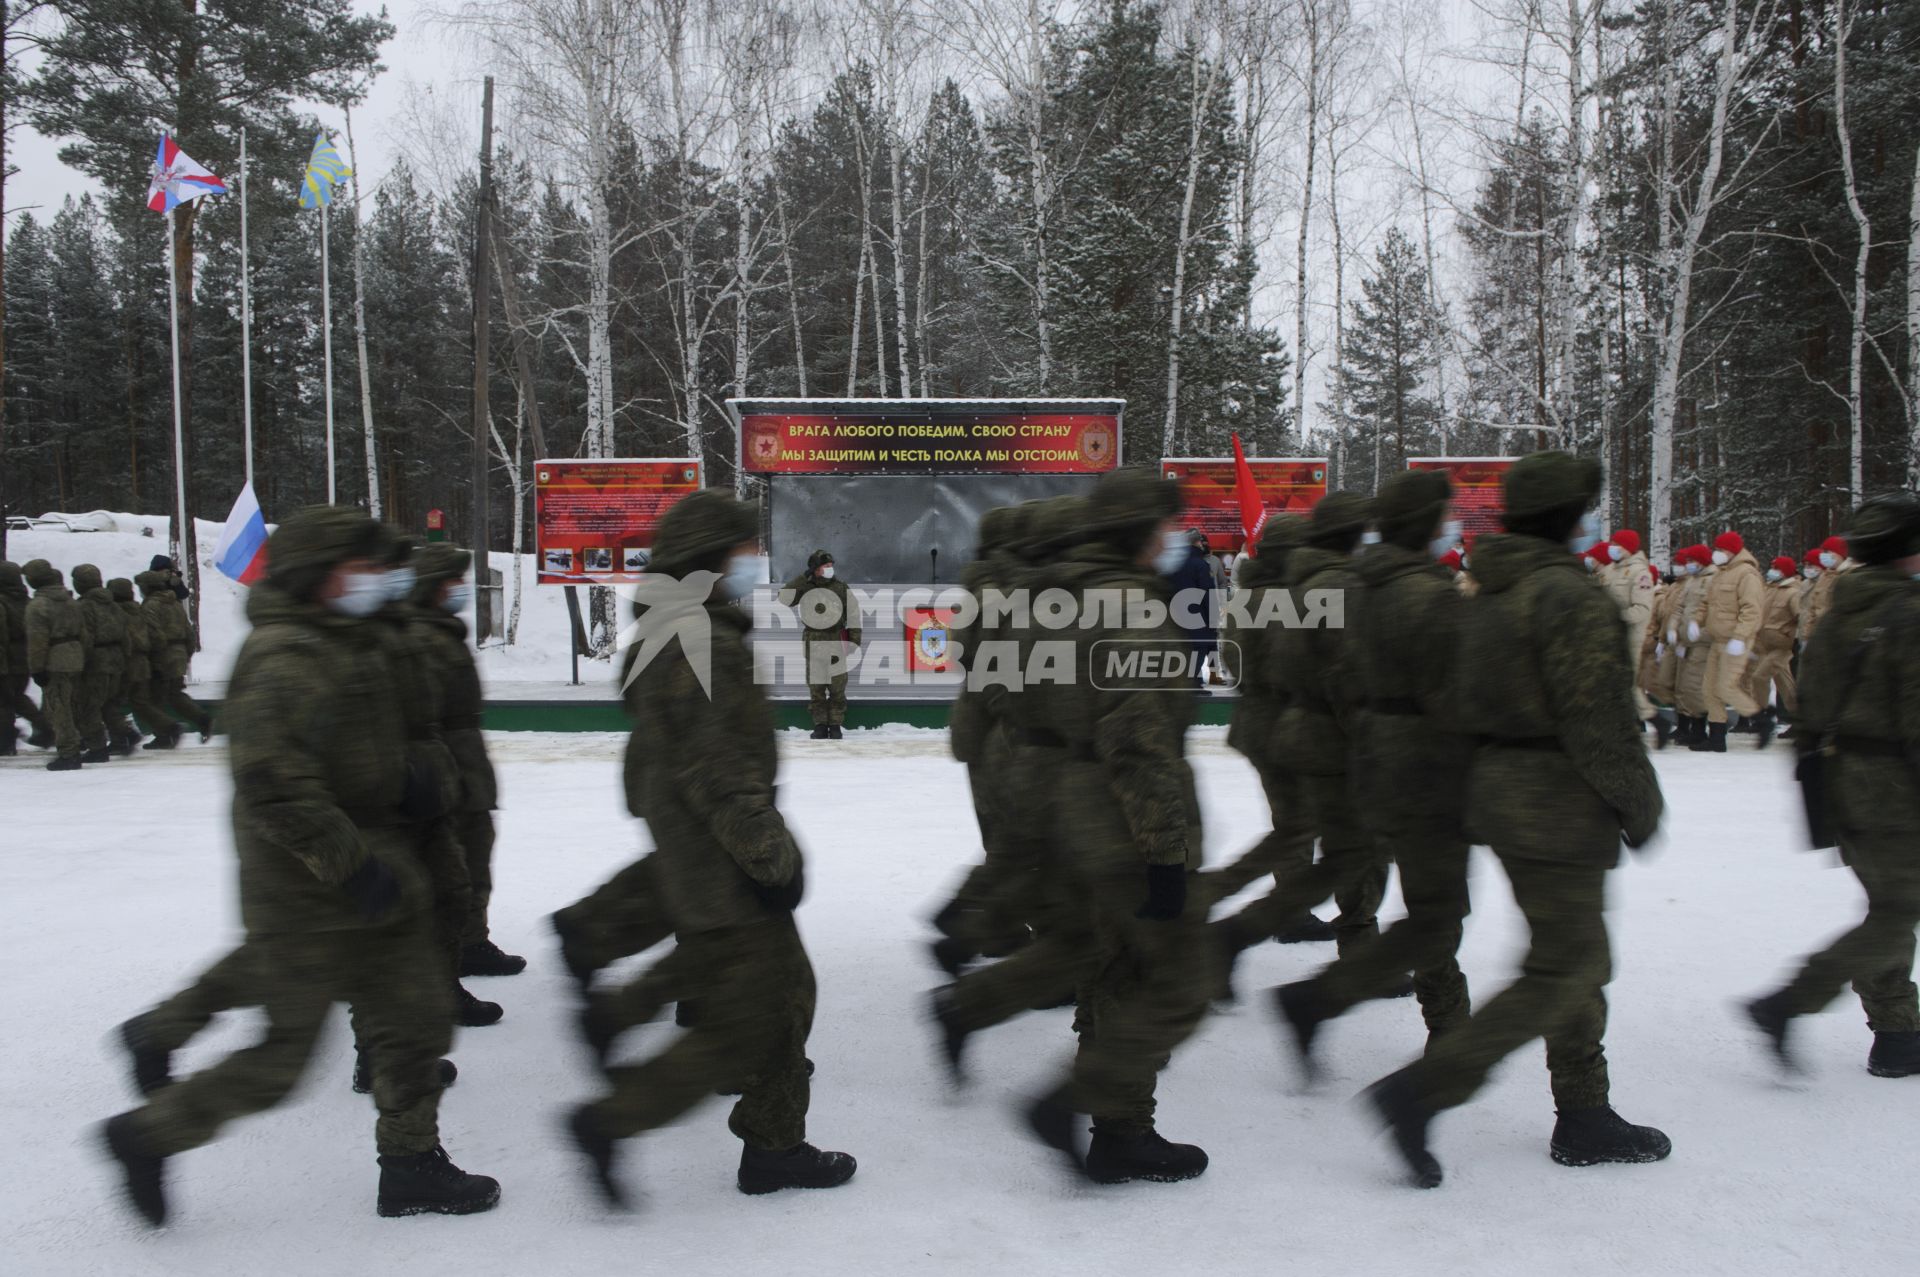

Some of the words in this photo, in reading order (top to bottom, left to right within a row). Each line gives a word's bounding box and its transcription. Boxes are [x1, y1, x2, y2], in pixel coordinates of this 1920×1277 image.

[789, 425, 830, 437] ВРАГА
[834, 425, 895, 437] ЛЮБОГО
[898, 425, 968, 438] ПОБЕДИМ,
[971, 425, 1016, 437] СВОЮ
[1020, 425, 1072, 437] СТРАНУ
[781, 450, 805, 461] МЫ
[808, 450, 876, 463] ЗАЩИТИМ
[879, 450, 888, 461] И
[891, 450, 931, 461] ЧЕСТЬ
[934, 449, 982, 461] ПОЛКА
[985, 449, 1009, 461] МЫ
[1012, 449, 1079, 461] ОТСТОИМ
